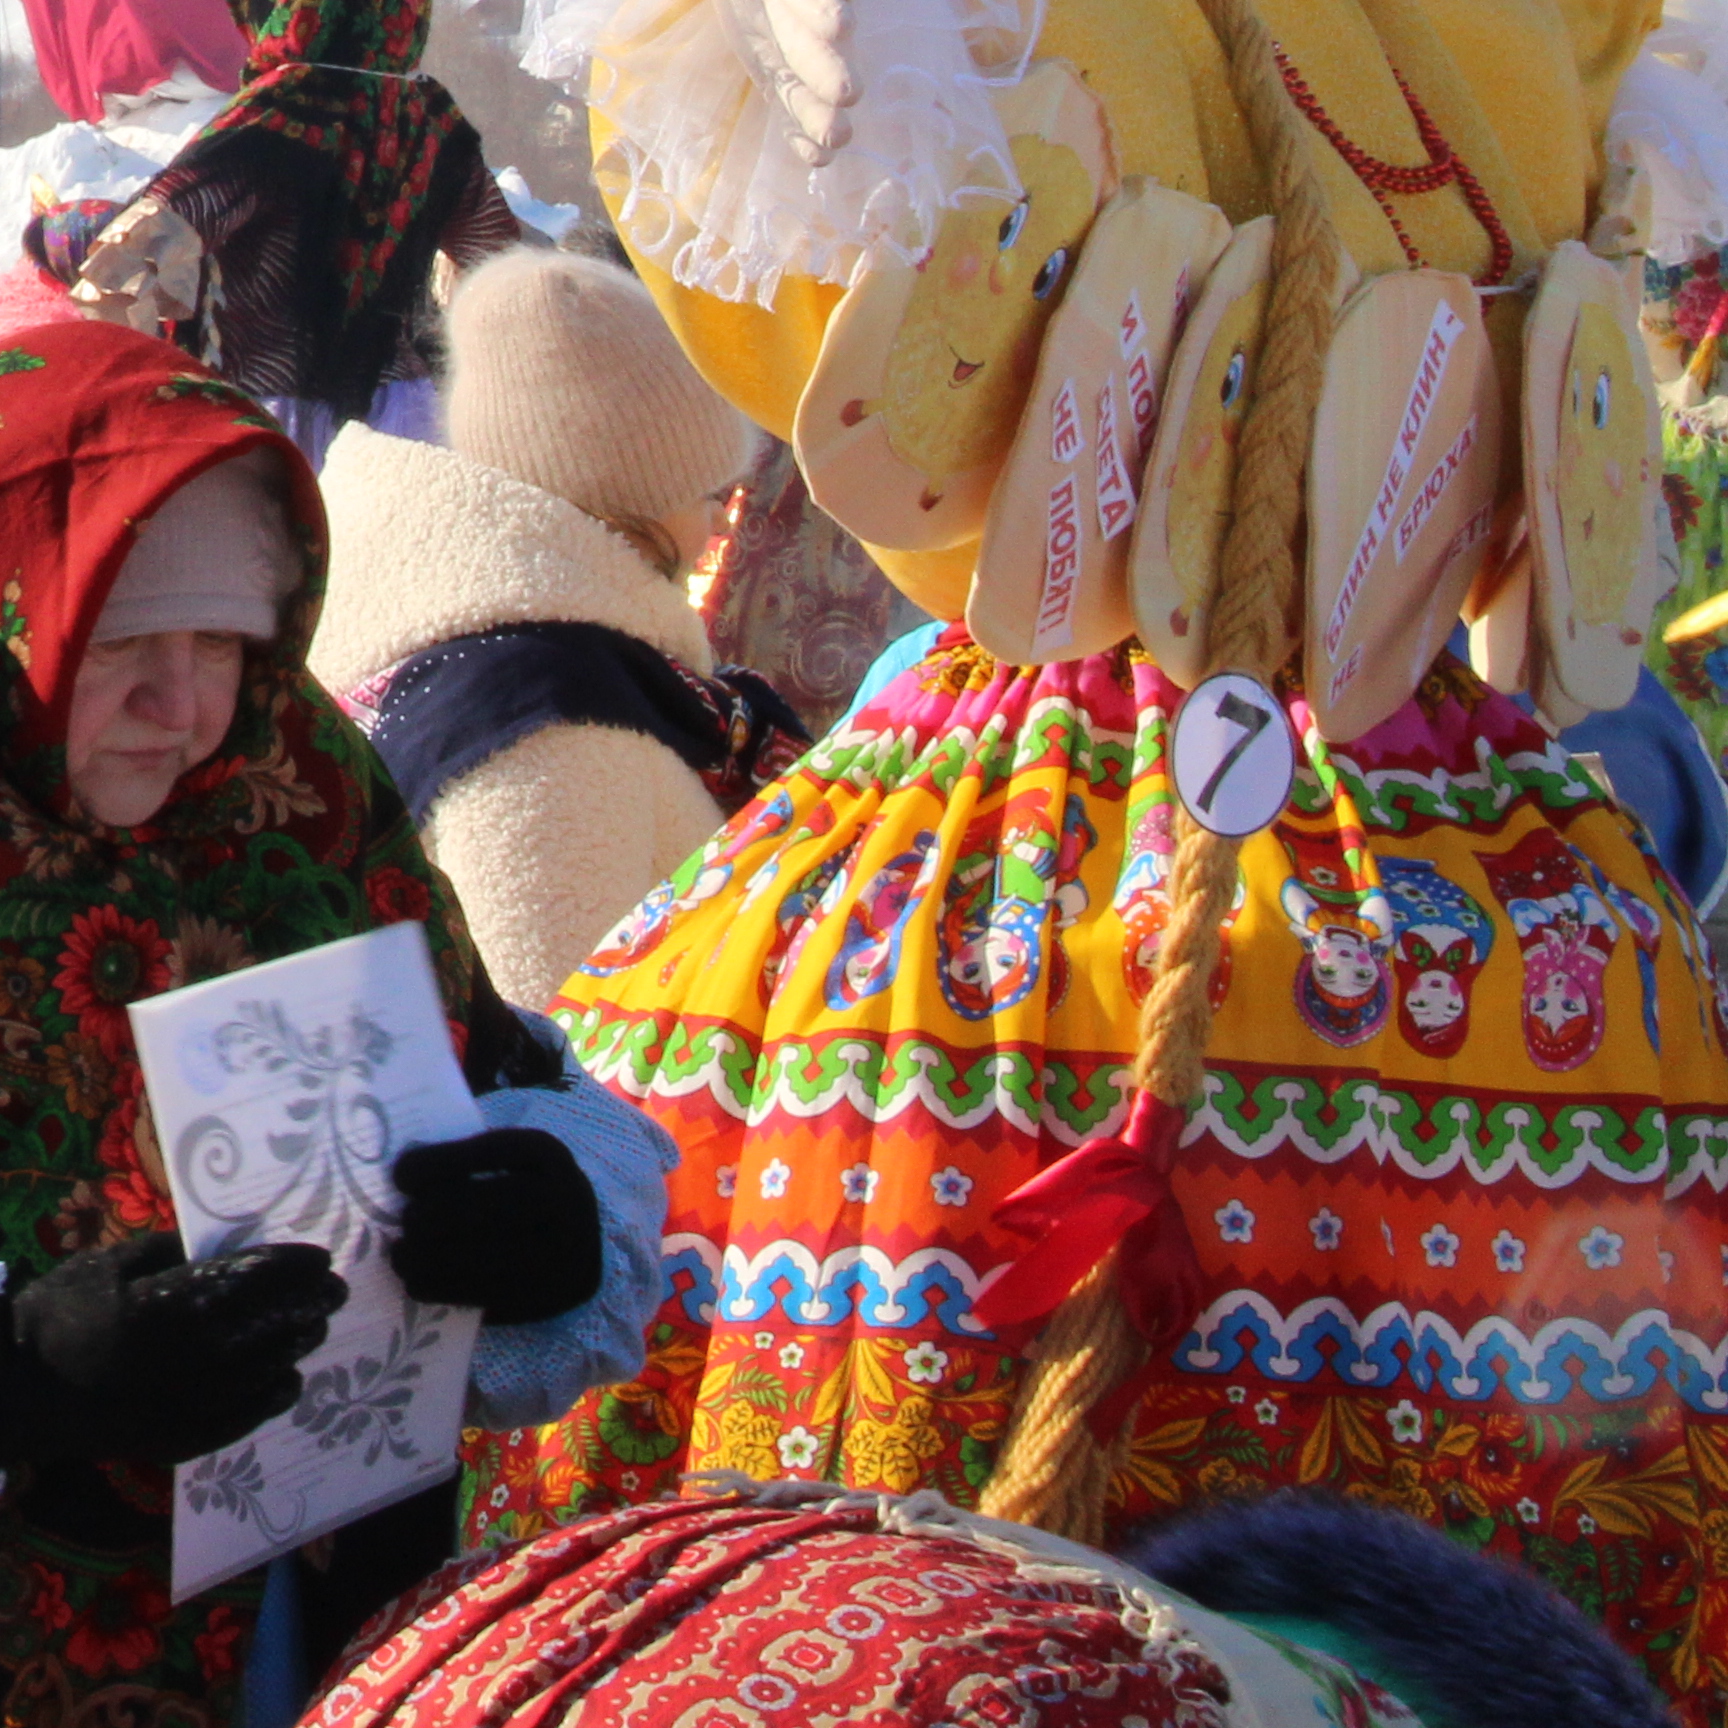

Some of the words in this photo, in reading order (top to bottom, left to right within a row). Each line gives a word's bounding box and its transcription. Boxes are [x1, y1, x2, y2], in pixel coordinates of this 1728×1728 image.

[1054, 390, 1079, 459] НЕ
[1325, 527, 1377, 653] БЛИН
[1376, 457, 1402, 522] НЕ
[1398, 334, 1447, 457] КЛИН
[1399, 426, 1475, 551] БРЮХА
[1039, 480, 1077, 634] ЛЮБЯТ!
[1331, 649, 1361, 700] НЕ
[1196, 690, 1271, 814] 7
